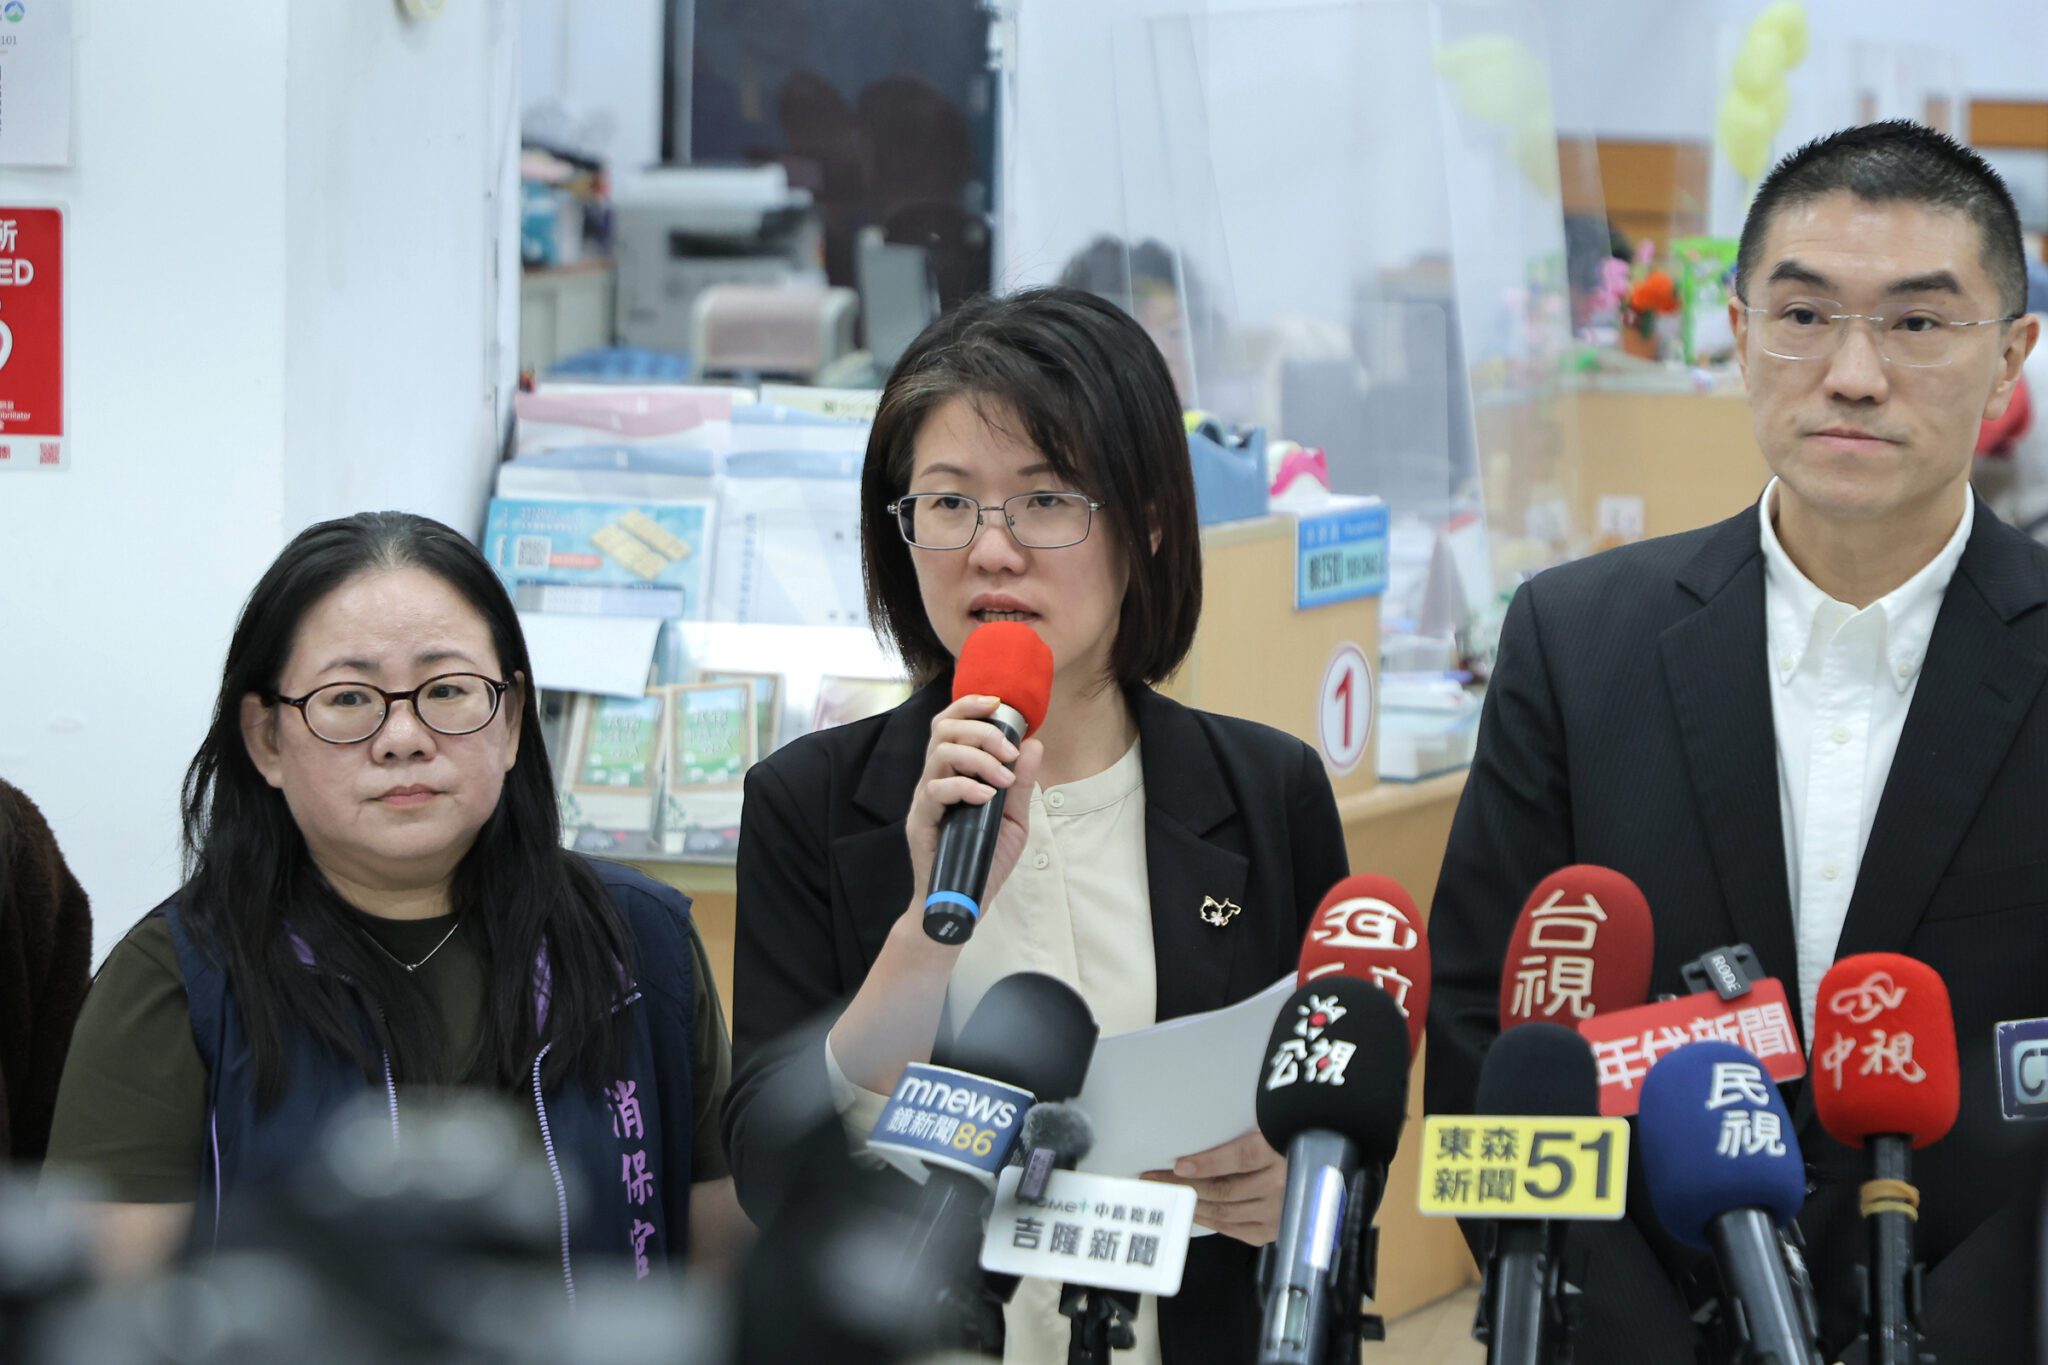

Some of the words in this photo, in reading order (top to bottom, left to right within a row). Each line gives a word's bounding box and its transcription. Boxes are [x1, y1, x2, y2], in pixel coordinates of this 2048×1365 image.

[1334, 665, 1354, 749] 1
[1511, 889, 1608, 1018] 台視
[1266, 1037, 1357, 1091] 公視
[1822, 1030, 1928, 1091] 中視
[897, 1076, 1018, 1129] mnews
[1705, 1061, 1787, 1159] 民視
[1436, 1125, 1519, 1160] 東森
[1524, 1129, 1614, 1201] 51
[604, 1079, 656, 1281] 消保官
[1432, 1166, 1516, 1203] 新聞
[1013, 1216, 1160, 1267] 吉隆新聞
